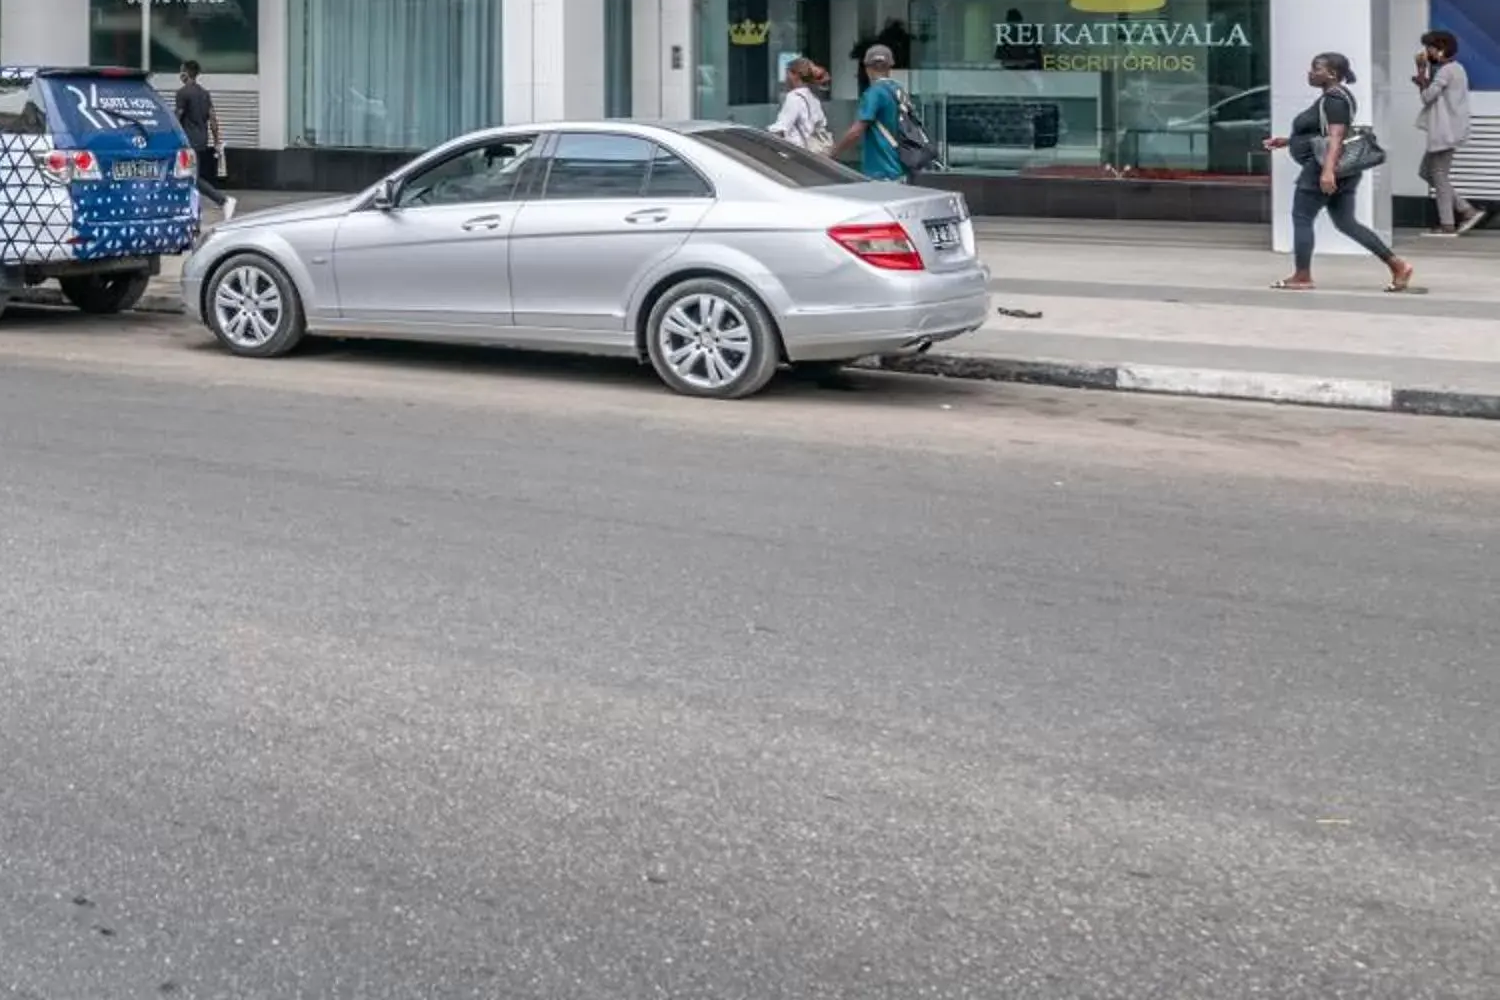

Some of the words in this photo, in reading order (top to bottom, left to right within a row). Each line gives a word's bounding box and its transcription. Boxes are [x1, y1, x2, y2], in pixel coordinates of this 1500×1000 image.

[994, 23, 1045, 46] REI
[1051, 22, 1251, 47] KATYAVALA
[1043, 51, 1196, 73] ESCRITÓRIOS
